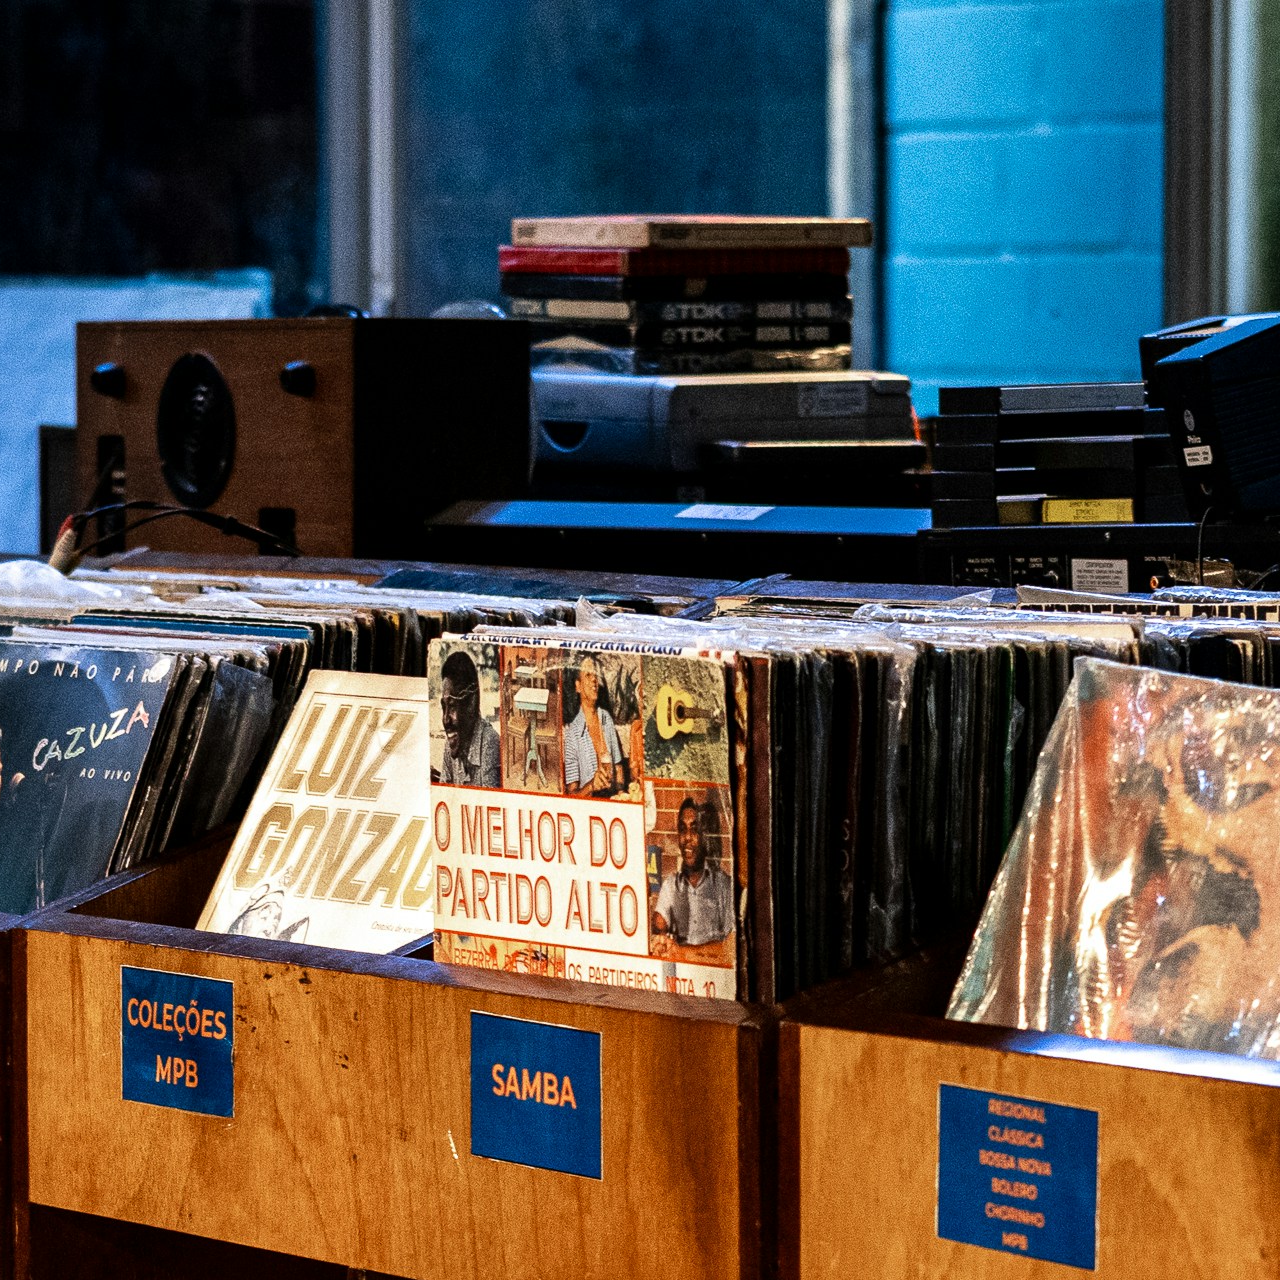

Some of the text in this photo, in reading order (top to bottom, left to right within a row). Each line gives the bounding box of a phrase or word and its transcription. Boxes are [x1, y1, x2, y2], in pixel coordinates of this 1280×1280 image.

[53, 660, 98, 681] NÃO
[32, 700, 150, 771] CAZUZA
[275, 702, 418, 802] LUIZ
[79, 768, 132, 783] AO VIVO
[435, 800, 628, 870] O MELHOR DO
[436, 864, 639, 938] PARTIDO ALTO
[454, 948, 500, 971] BEZERRA
[504, 954, 519, 973] DA
[568, 963, 583, 981] OS
[589, 966, 658, 991] PARTIDEIROS
[665, 975, 695, 997] NOTA
[702, 980, 717, 999] 10
[127, 996, 227, 1042] COLEÇÕES
[155, 1054, 199, 1089] MPB
[492, 1063, 578, 1110] SAMBA
[991, 1177, 1038, 1200] BOLERO
[1017, 1157, 1052, 1177] NOVA
[1001, 1231, 1028, 1251] MPB
